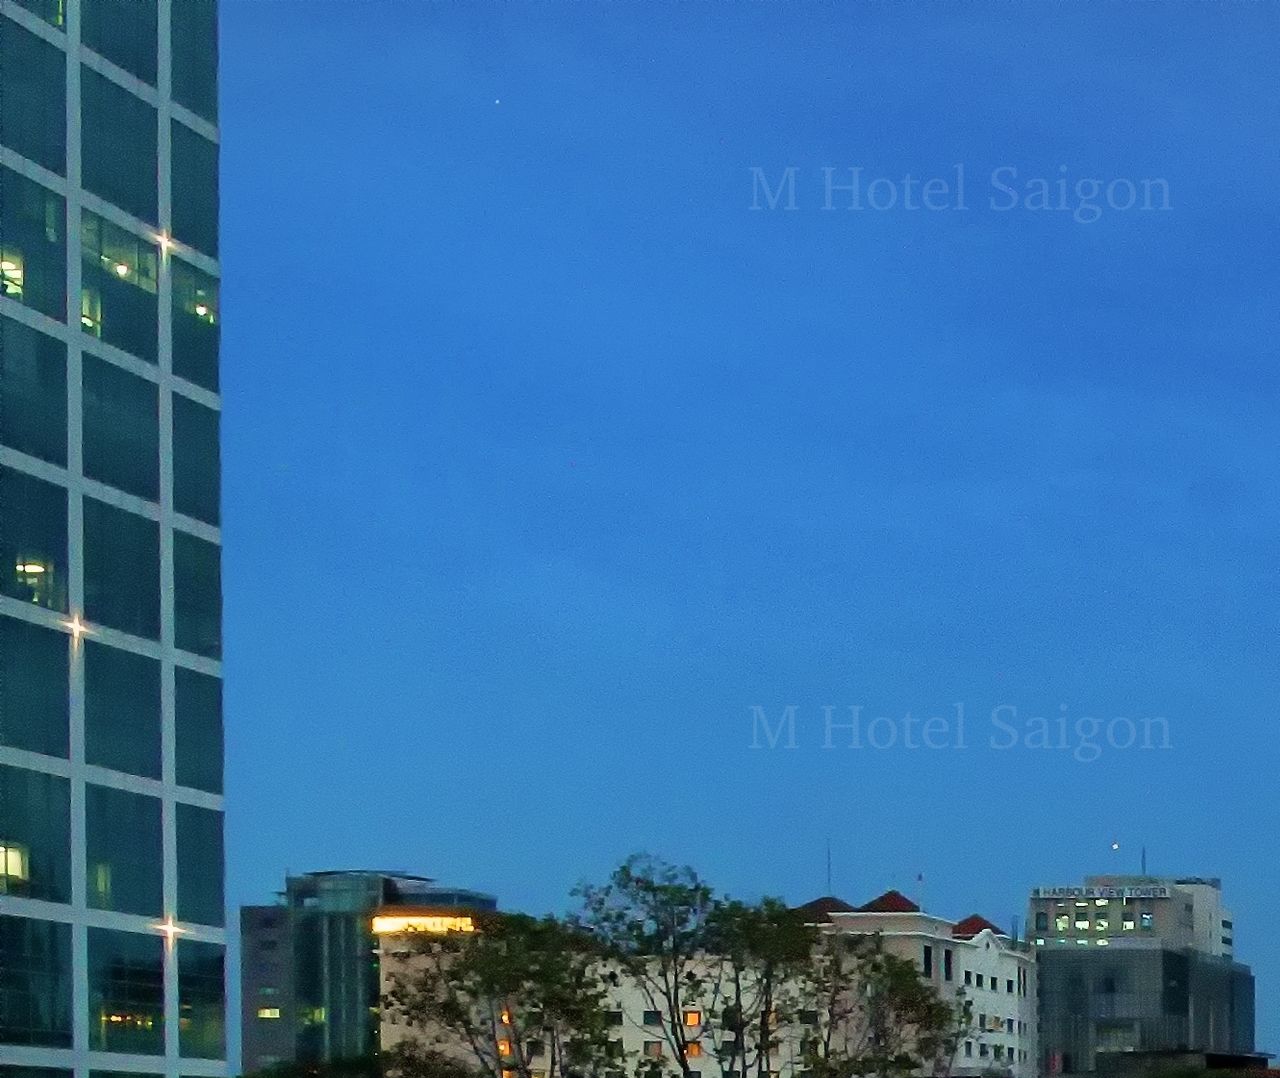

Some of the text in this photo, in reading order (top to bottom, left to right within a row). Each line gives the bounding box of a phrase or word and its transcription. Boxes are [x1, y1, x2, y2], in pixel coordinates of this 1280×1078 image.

[1044, 887, 1167, 897] HARBOUR VIEW TOWER
